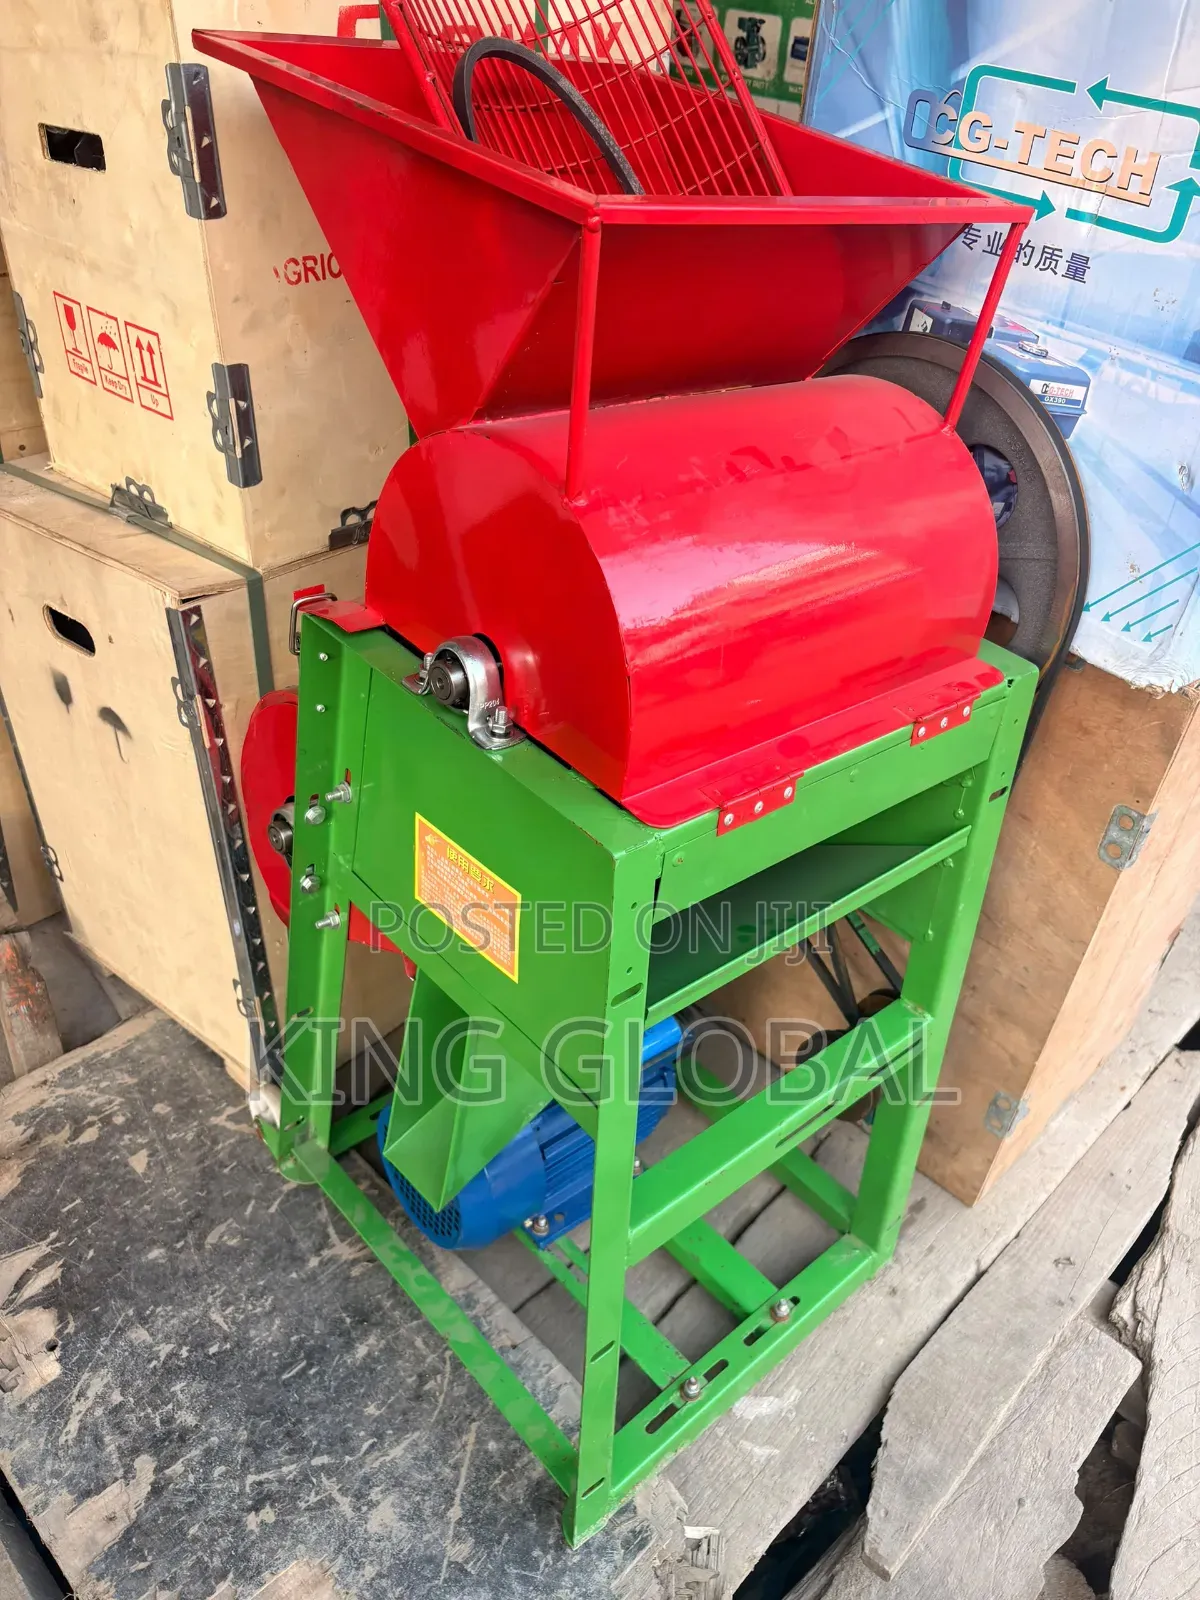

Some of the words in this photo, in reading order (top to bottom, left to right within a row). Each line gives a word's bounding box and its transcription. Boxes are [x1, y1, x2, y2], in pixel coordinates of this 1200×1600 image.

[961, 223, 1091, 284] 专业的质量
[72, 358, 89, 375] Fragile
[104, 374, 118, 389] Keep
[117, 380, 128, 396] Dry
[150, 393, 159, 408] Up
[1044, 395, 1066, 405] GX390
